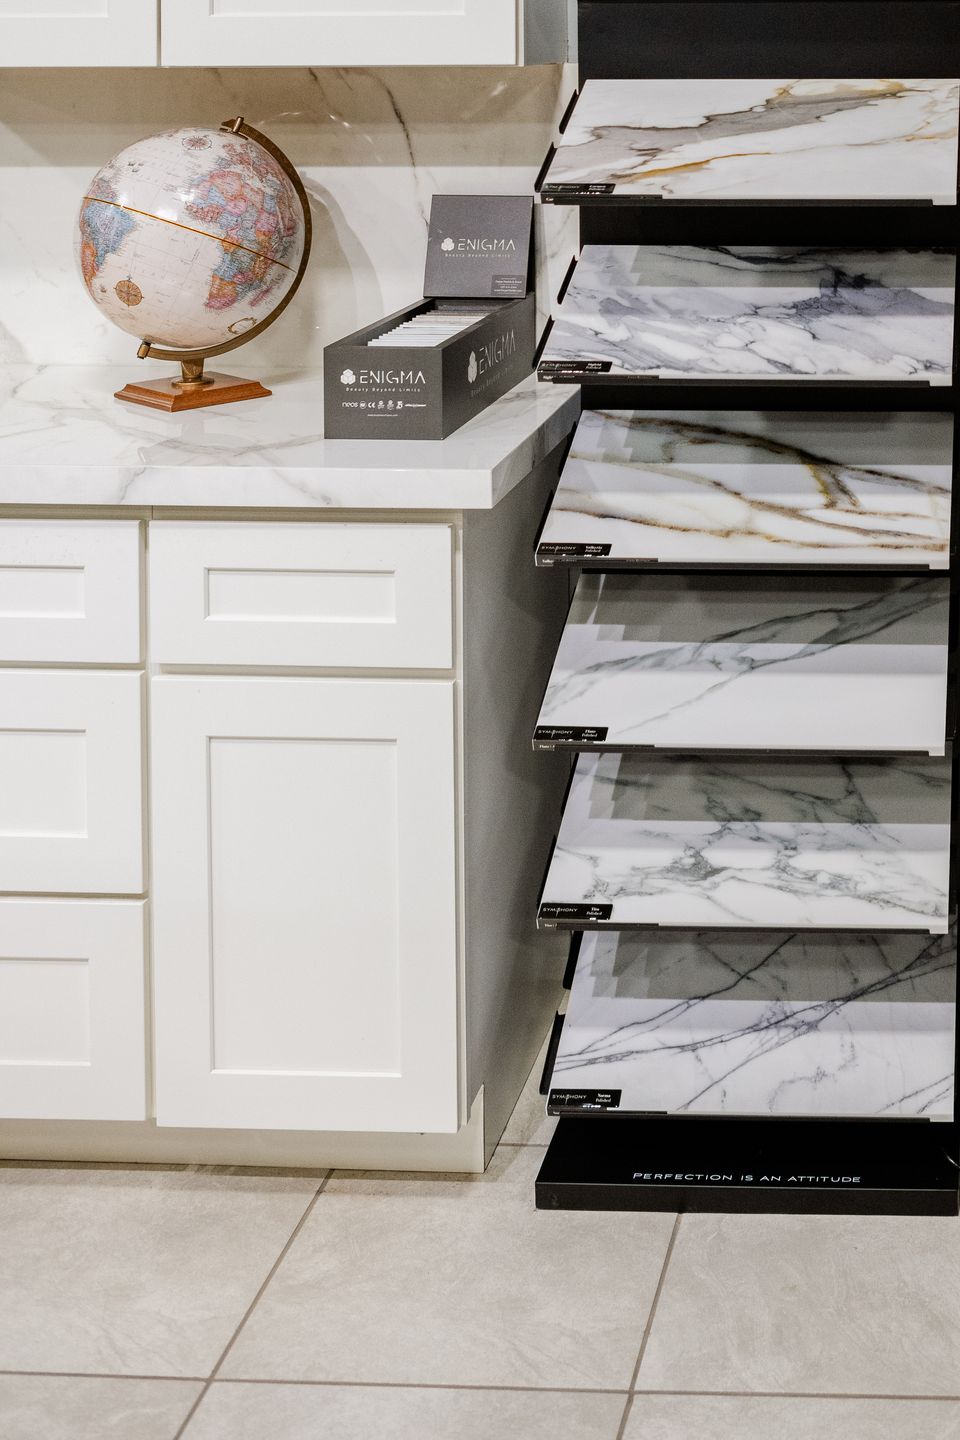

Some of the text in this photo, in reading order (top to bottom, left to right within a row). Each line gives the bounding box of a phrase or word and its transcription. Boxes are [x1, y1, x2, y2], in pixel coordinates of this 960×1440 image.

[457, 238, 516, 251] ENIGMA
[360, 370, 426, 384] ENIGMA
[633, 1172, 732, 1181] PERFECTION
[787, 1175, 861, 1183] ATTITUDE
